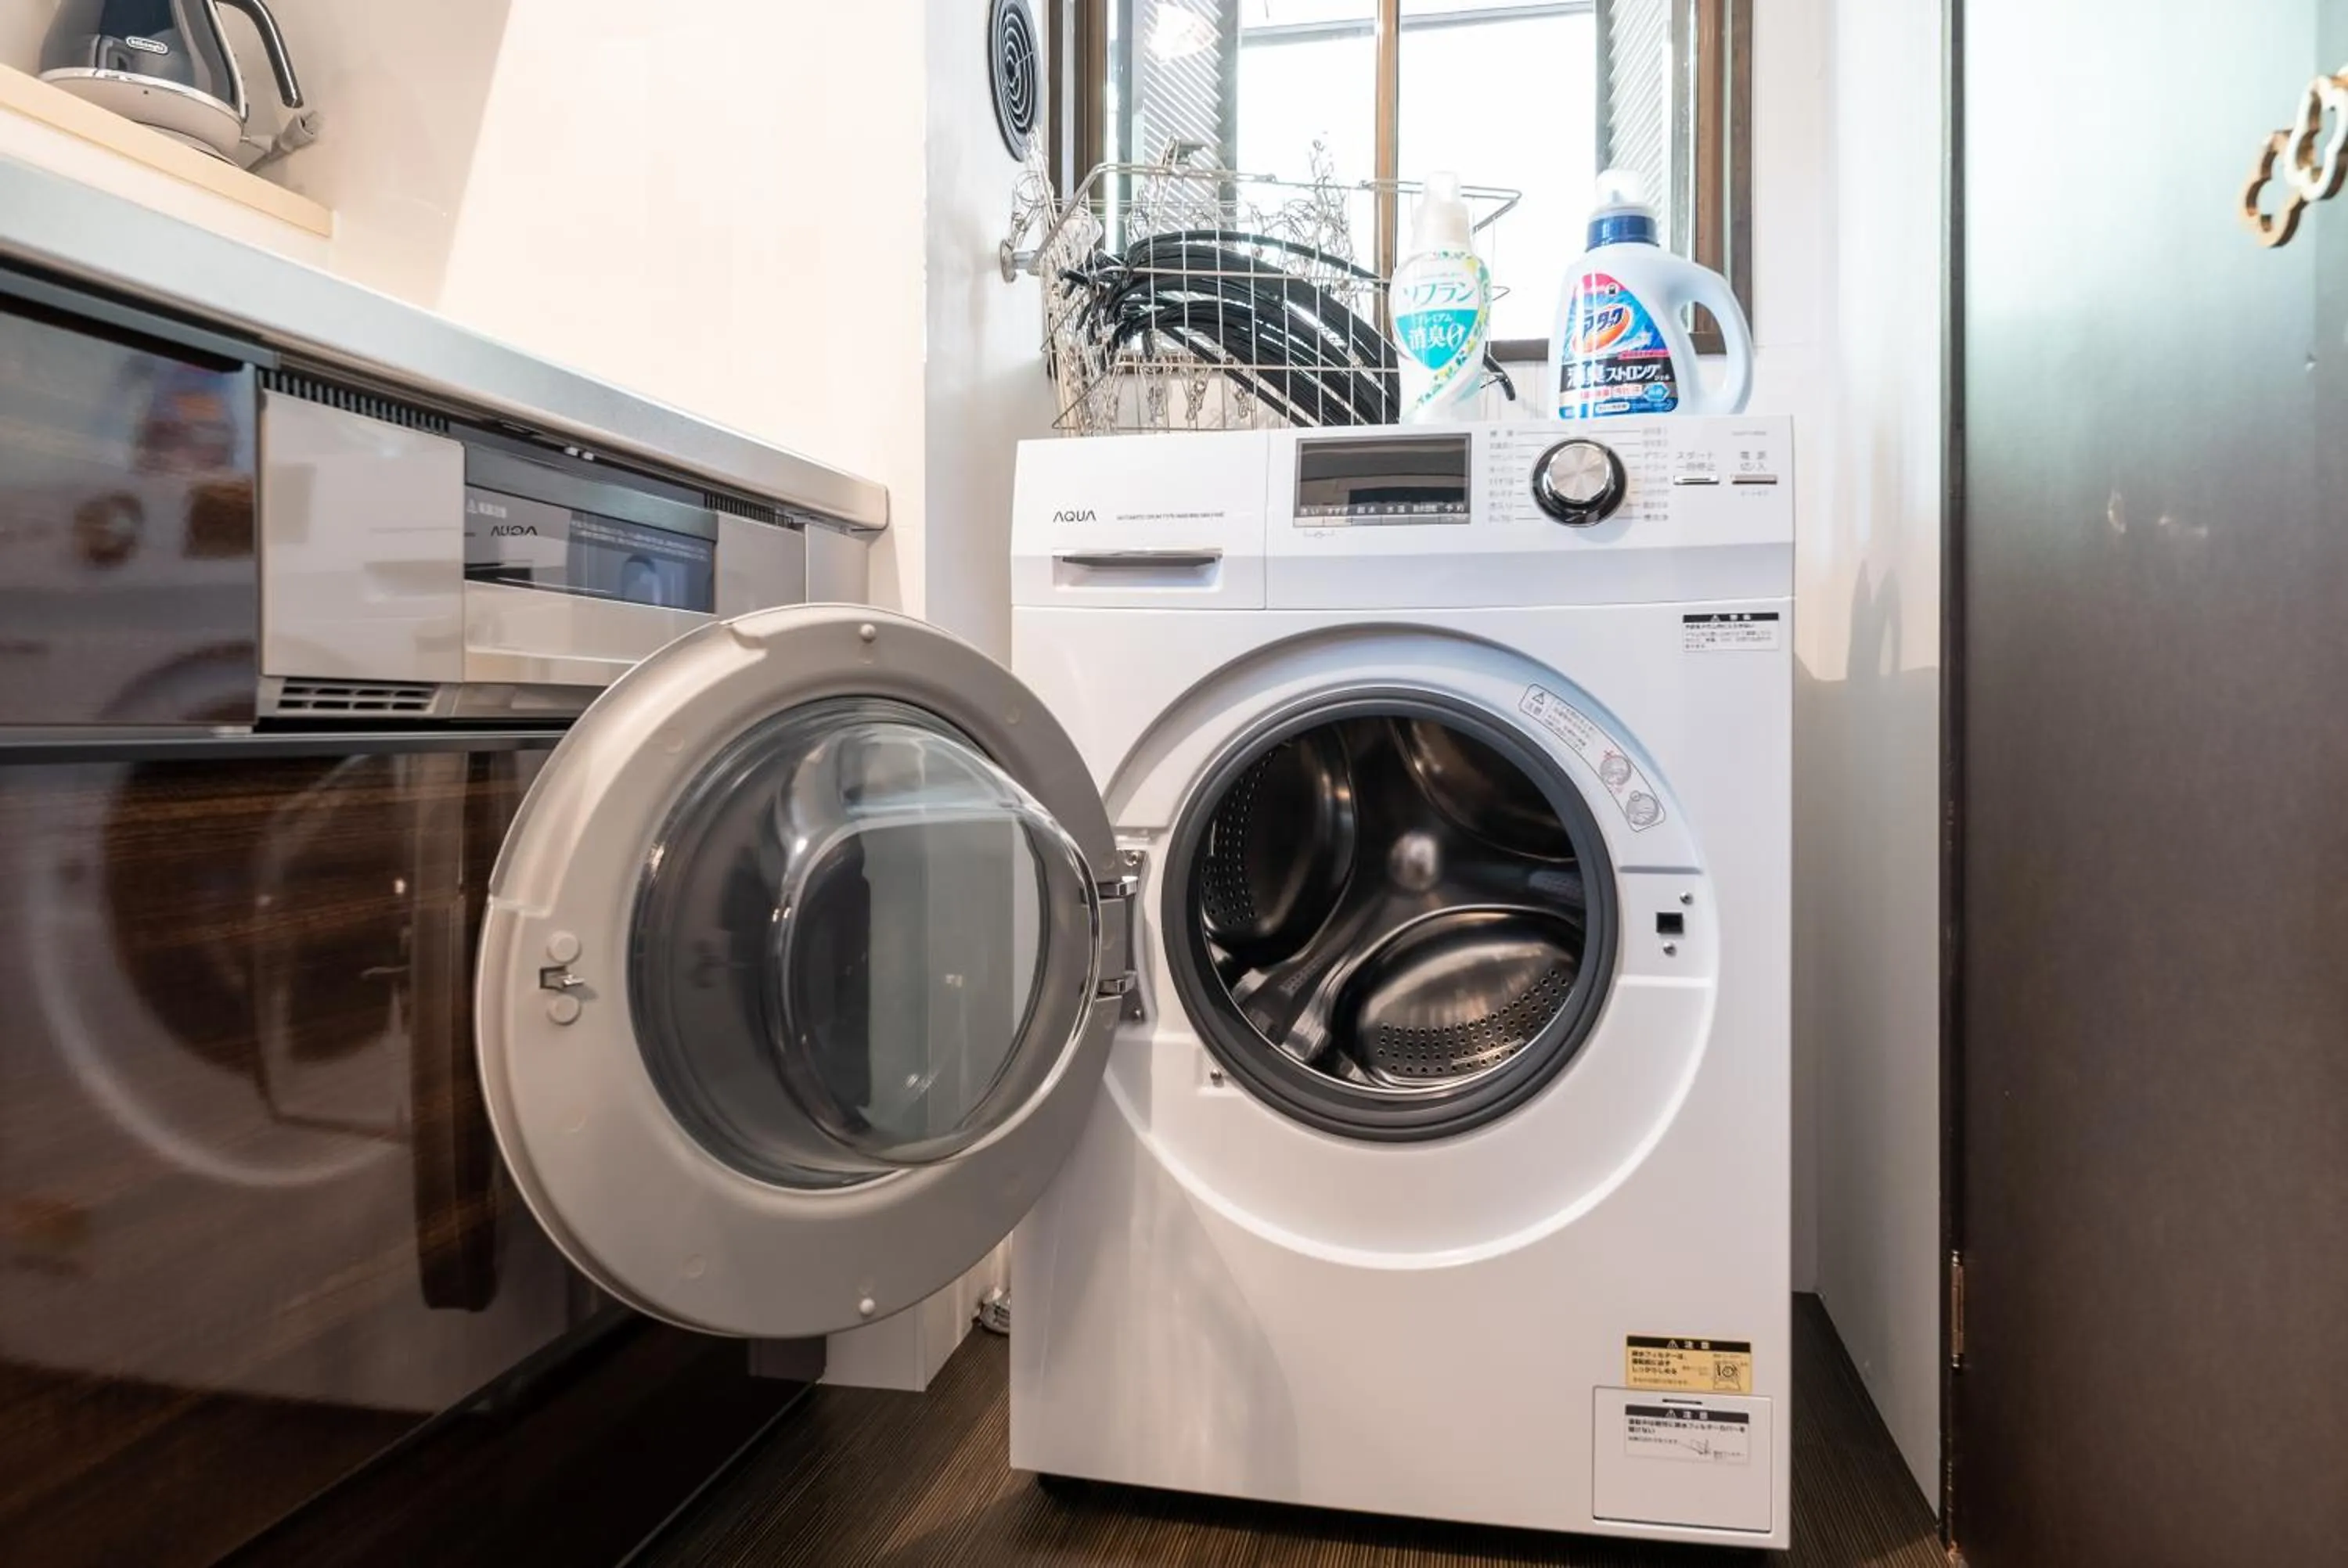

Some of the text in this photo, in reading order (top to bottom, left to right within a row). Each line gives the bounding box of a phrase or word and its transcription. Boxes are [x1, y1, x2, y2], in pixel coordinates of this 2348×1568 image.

[1402, 281, 1475, 308] ソフラン
[1053, 509, 1097, 523] AQUA
